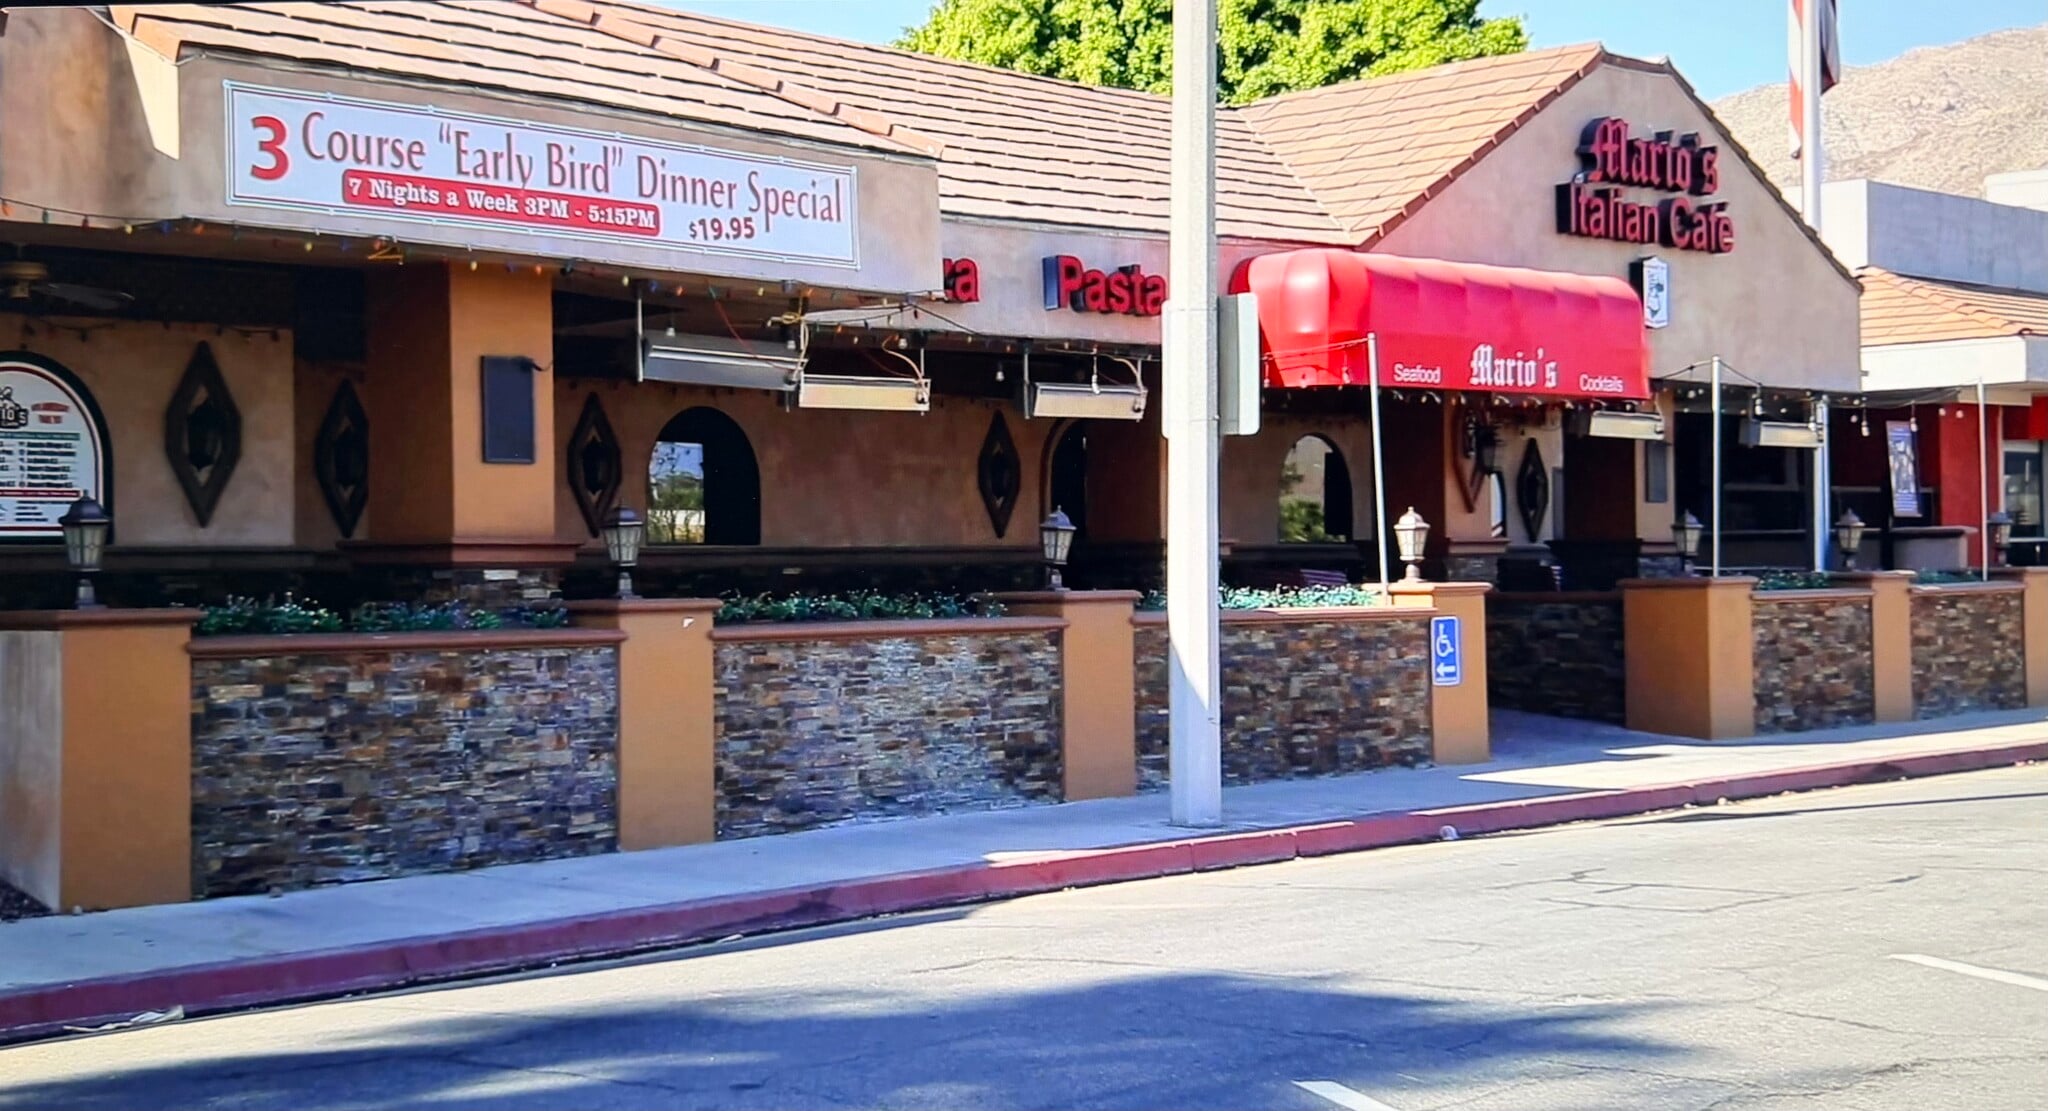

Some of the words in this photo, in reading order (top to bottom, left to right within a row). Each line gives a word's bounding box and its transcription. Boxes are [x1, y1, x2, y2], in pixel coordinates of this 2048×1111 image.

[250, 116, 289, 180] 3
[302, 112, 425, 170] Course
[637, 155, 736, 209] Dinner
[748, 171, 842, 232] Special
[1576, 116, 1719, 196] Mario's
[349, 178, 361, 195] 7
[369, 178, 439, 206] Nights
[446, 194, 460, 208] a
[465, 189, 518, 213] Week
[525, 197, 569, 218] 3PM
[588, 204, 656, 229] 5:15PM
[689, 216, 755, 241] $19.95
[1556, 182, 1660, 244] Italian
[1043, 255, 1167, 316] Pasta
[1394, 364, 1441, 384] Seafood
[1469, 344, 1558, 388] Mario's
[1579, 374, 1624, 393] Cocktails
